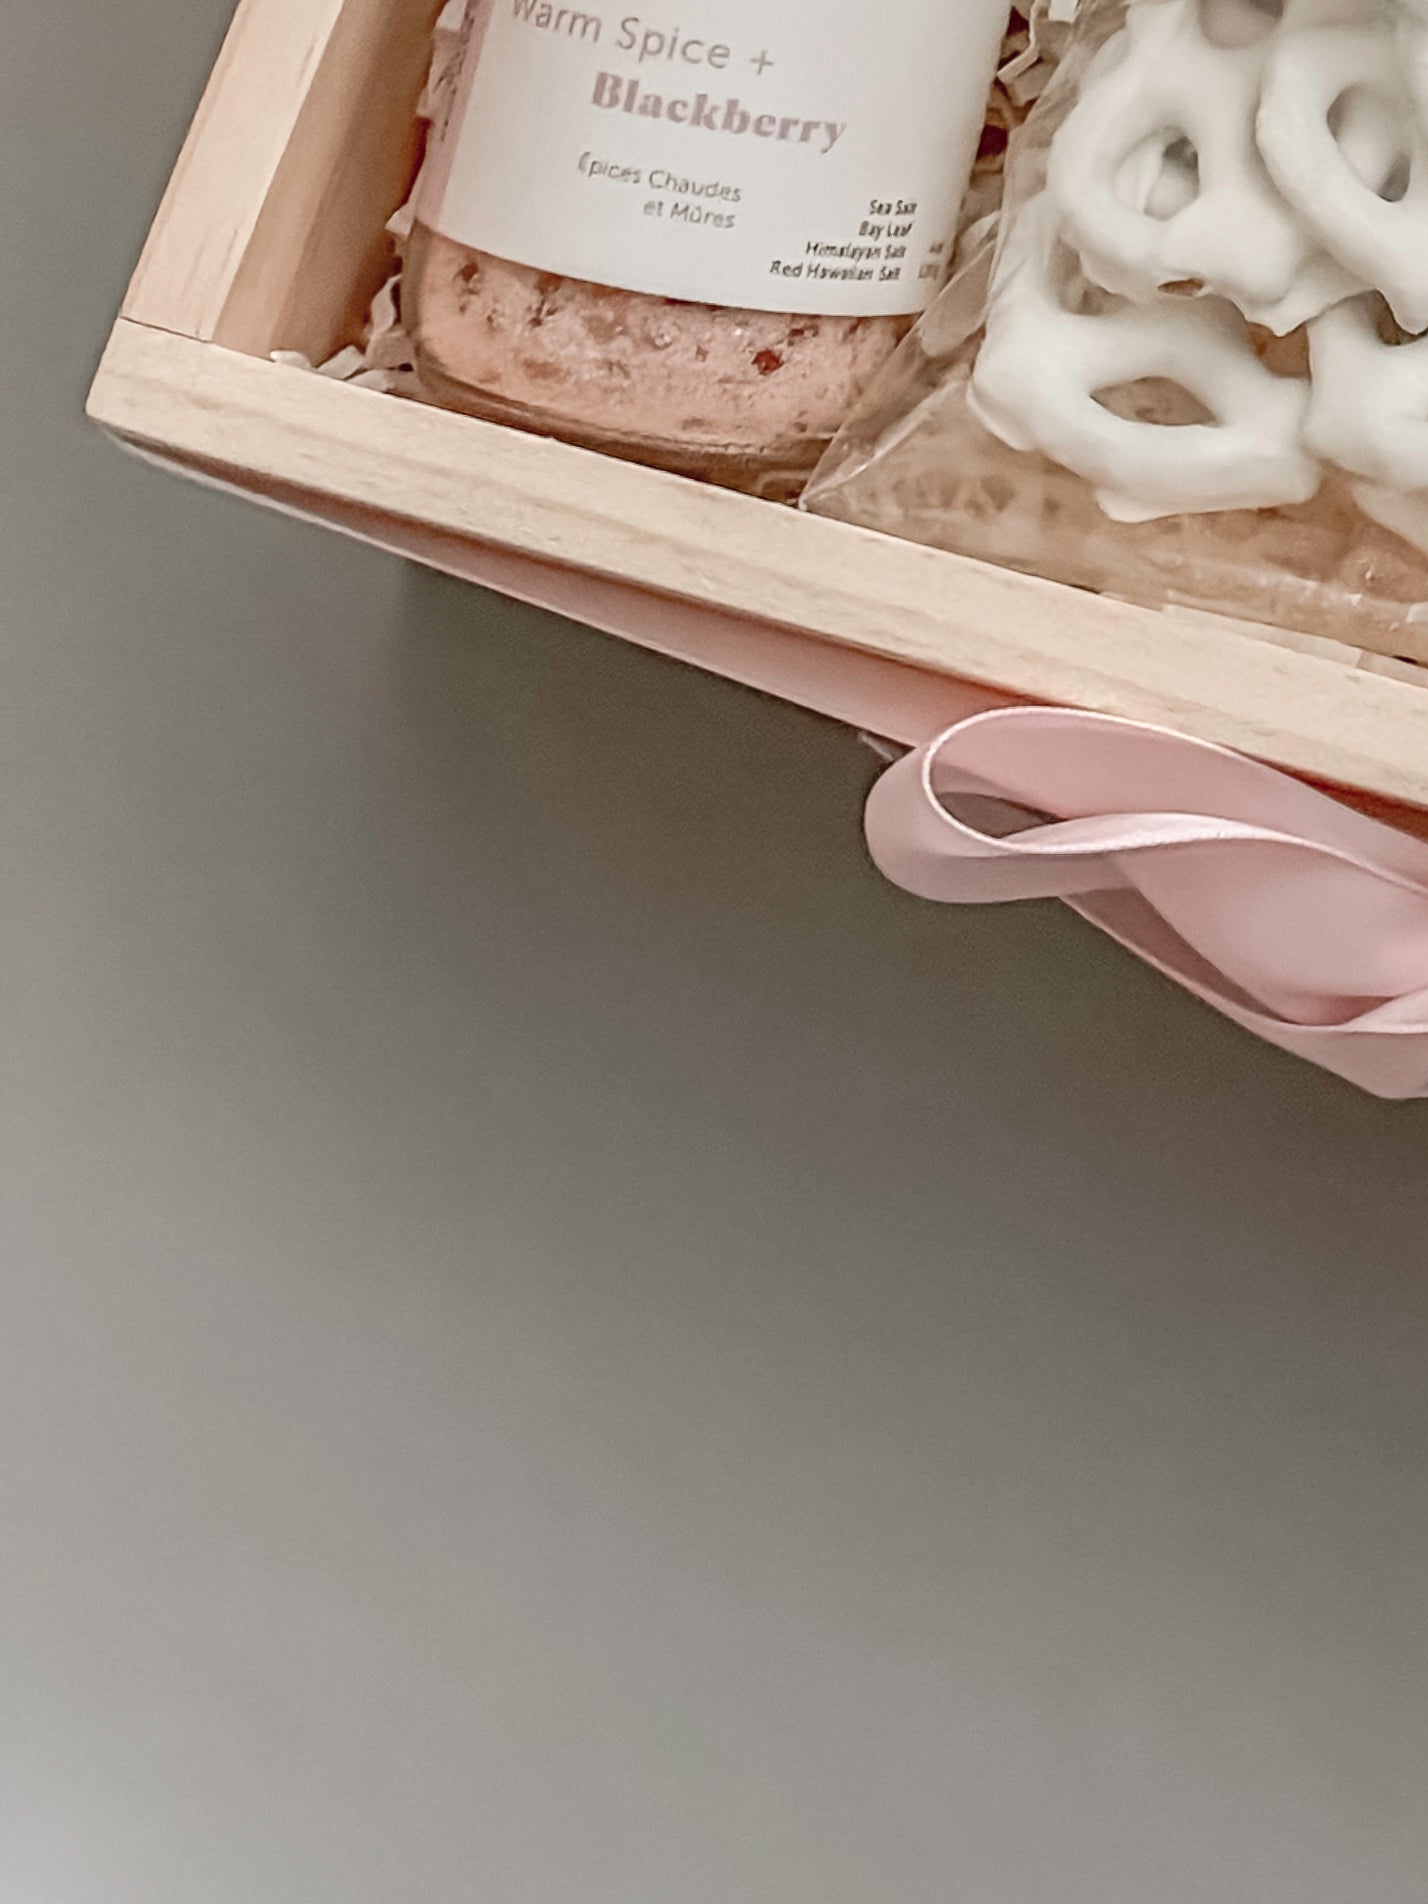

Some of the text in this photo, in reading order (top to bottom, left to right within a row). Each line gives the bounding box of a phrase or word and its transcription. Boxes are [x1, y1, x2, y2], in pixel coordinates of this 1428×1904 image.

[614, 15, 731, 70] Spice
[590, 70, 849, 155] Blackberry
[648, 169, 741, 203] Chaudes
[643, 200, 736, 228] et Mûres
[768, 259, 802, 278] Red
